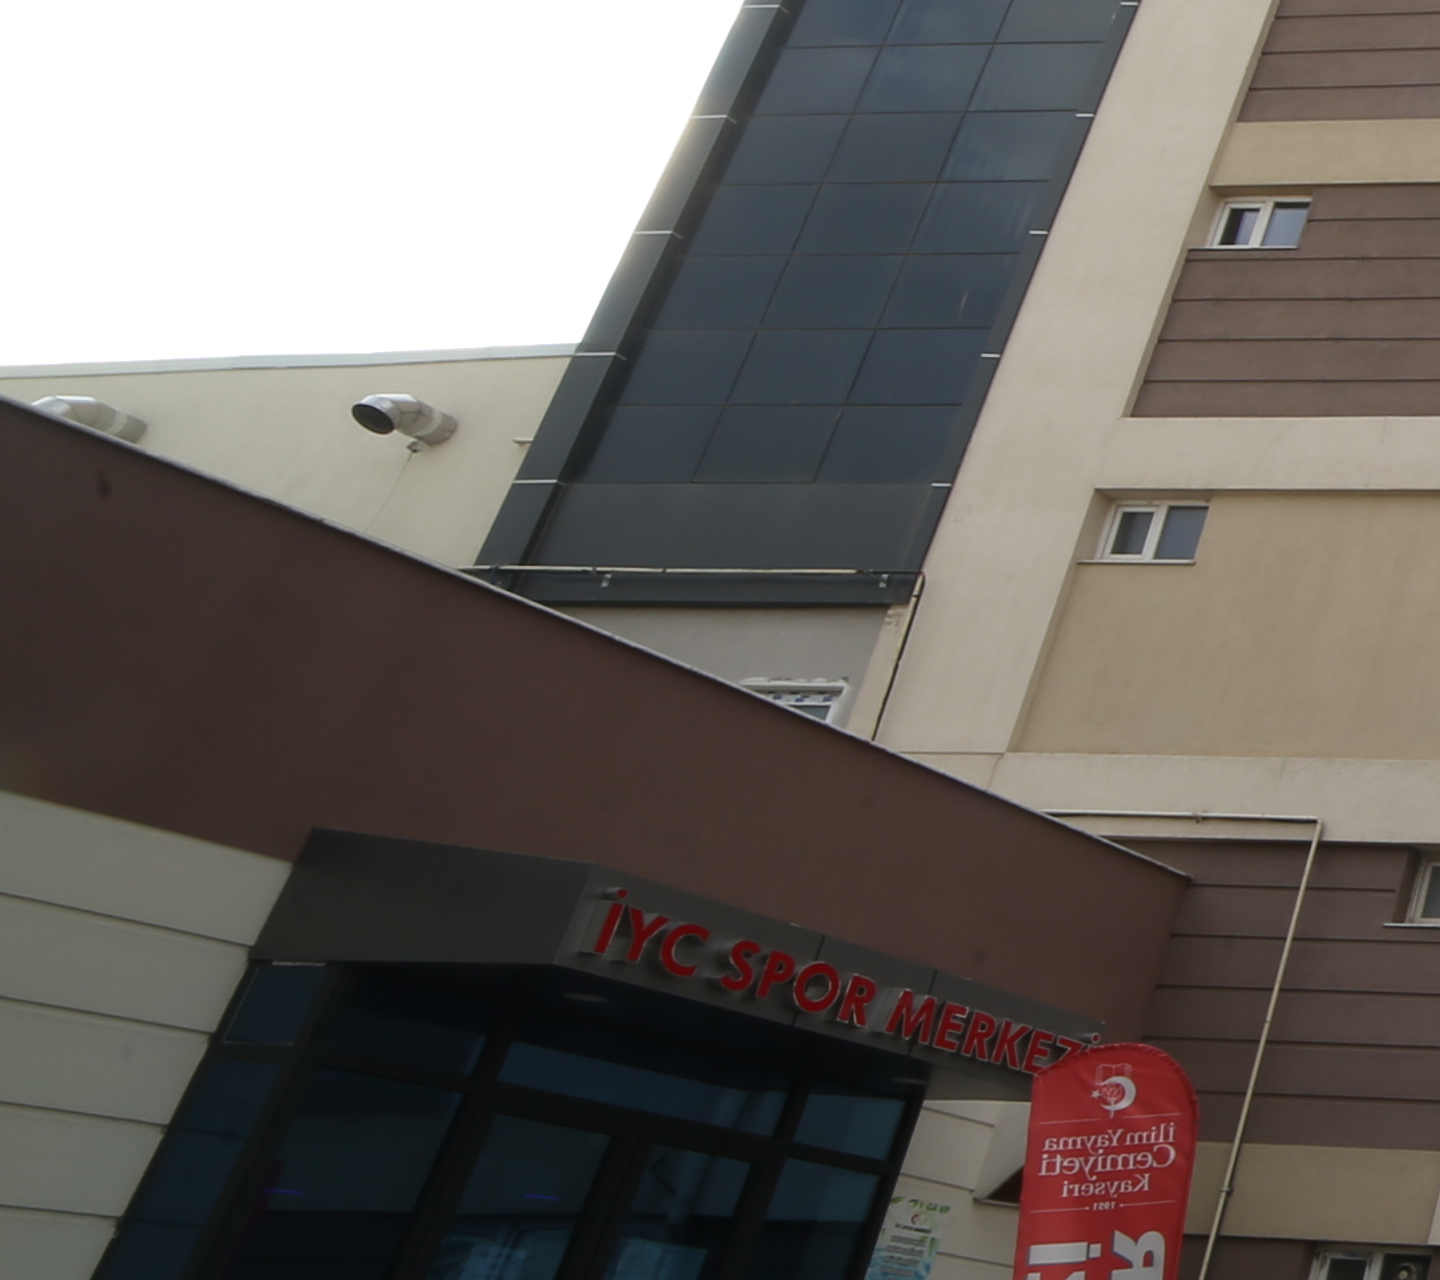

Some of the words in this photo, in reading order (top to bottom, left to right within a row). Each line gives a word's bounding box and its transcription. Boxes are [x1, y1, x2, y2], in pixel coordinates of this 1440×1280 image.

[594, 888, 710, 977] İYC
[719, 939, 878, 1028] SPOR
[884, 988, 1100, 1077] MERKEZ
